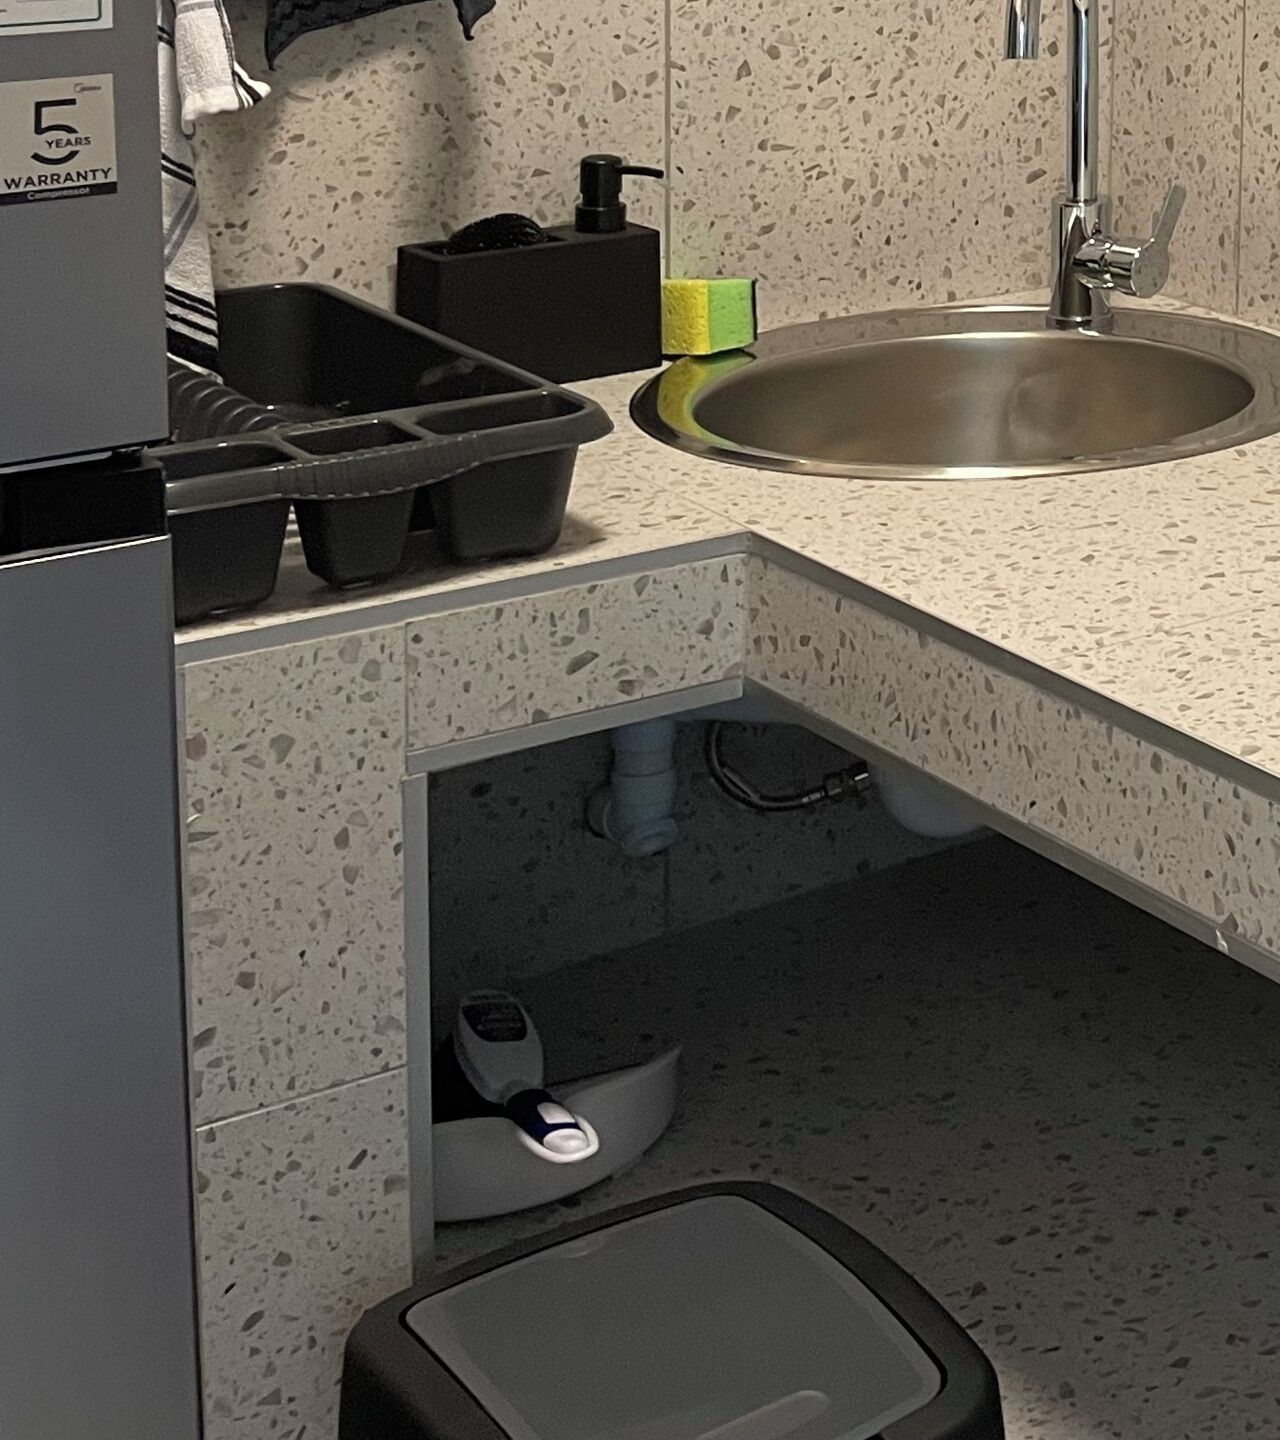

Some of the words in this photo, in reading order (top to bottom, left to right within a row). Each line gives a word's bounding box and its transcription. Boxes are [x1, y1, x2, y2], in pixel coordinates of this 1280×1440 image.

[30, 98, 80, 166] 5
[45, 136, 92, 149] YEARS
[4, 167, 112, 190] WARRANTY
